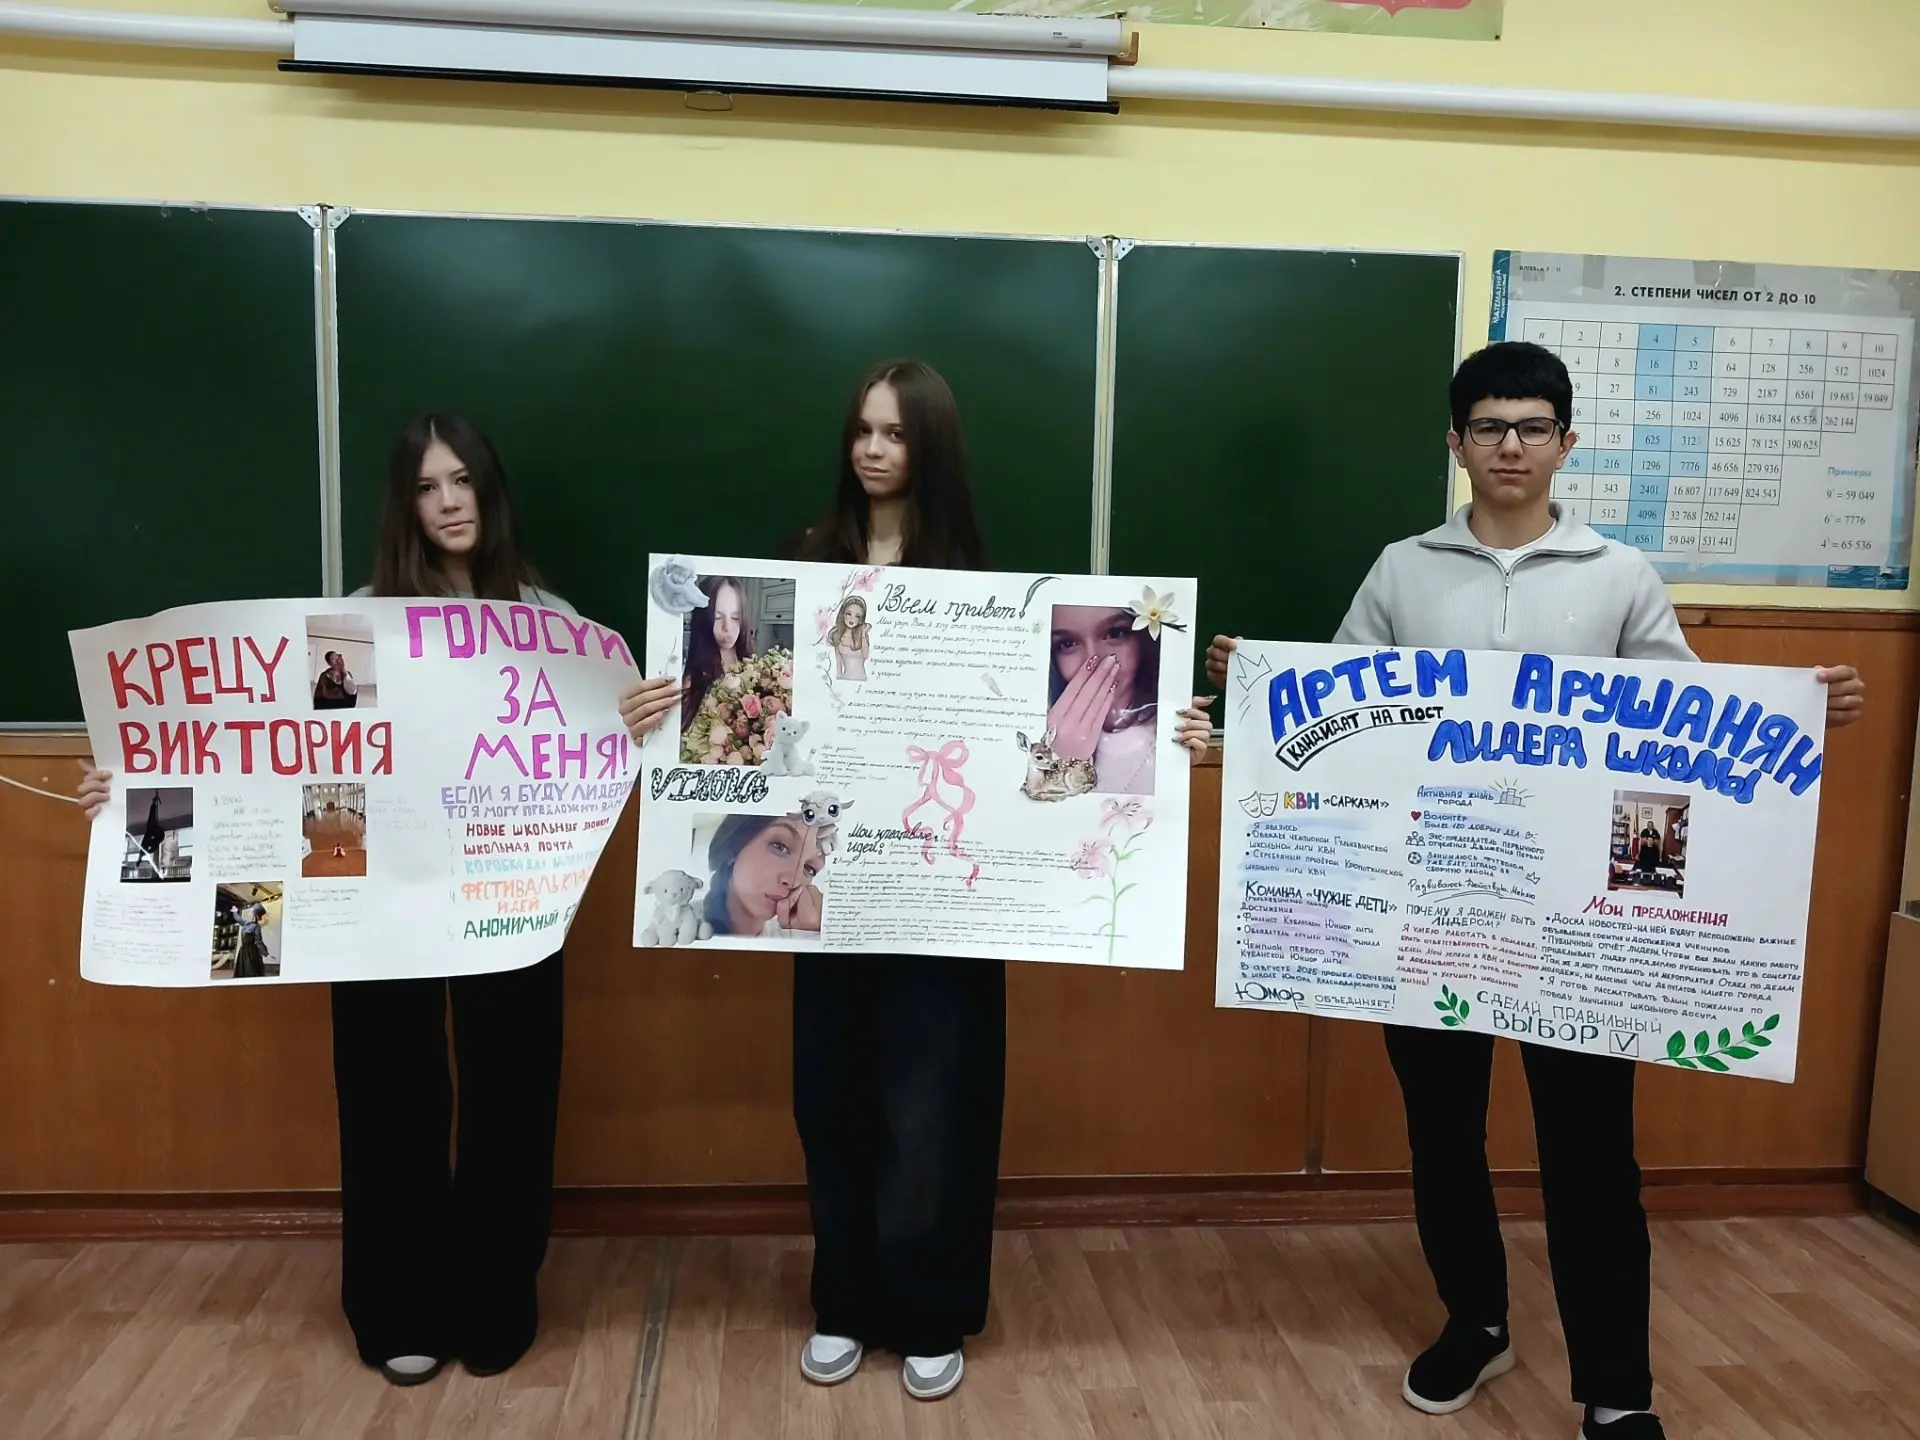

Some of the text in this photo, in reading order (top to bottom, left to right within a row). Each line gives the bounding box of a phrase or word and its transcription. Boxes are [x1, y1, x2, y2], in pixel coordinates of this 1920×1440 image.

[1614, 286, 1816, 305] 2. СТЕПЕНИ ЧИСЕЛ ОТ 2 ДО 10
[1577, 332, 1884, 353] 2 3 4 5 6 7 10
[1614, 358, 1886, 378] 8 16 32 64 128 256 512 1024
[1610, 384, 1814, 400] 27 81 243 729 2187 6561
[1609, 409, 1739, 422] 64 256 1024 4096
[1607, 434, 1660, 445] 125 625
[1569, 458, 1700, 471] 36 216 1296 7776
[1568, 483, 1659, 495] 49 343 2401
[1601, 509, 1657, 520] 512 4096
[1845, 515, 1866, 525] 7776
[1635, 533, 1654, 544] 6561
[878, 584, 937, 614] Всем
[108, 636, 289, 709] КРЕЦУ
[497, 666, 567, 726] ЗА
[1269, 648, 1822, 796] АРТЁМ АРУШАНЯН
[1286, 706, 1444, 761] КАНДИДАТ НА ПОСТ
[119, 721, 392, 775] ВИКТОРИЯ
[464, 733, 628, 780] МЕНЯ!
[1427, 719, 1762, 804] ЛИДЕРА ШКОЛЫ
[441, 783, 569, 804] ЕСЛИ Я БУДУ
[1283, 791, 1390, 810] КВН «САРКАЗМ»
[1417, 785, 1462, 798] АКТИВНАЯ
[444, 805, 467, 819] ТО
[471, 805, 480, 817] Я
[484, 805, 518, 818] МОГУ
[466, 823, 578, 837] НОВЫЕ ШКОЛЬНЫЕ
[1503, 829, 1520, 837] ДЕЛ
[464, 840, 573, 855] ШКОЛЬНАЯ ПОЧТА
[1318, 845, 1336, 855] КВН
[461, 874, 559, 901] ФЕСТИВАЛЬ
[1246, 880, 1302, 899] КОМАНДА
[1306, 888, 1352, 907] «ЧУЖИЕ
[1355, 895, 1397, 914] ДЕТИ»
[497, 897, 540, 914] ИДЕЙ
[1406, 904, 1536, 925] ПОЧЕМУ Я ДОЛЖЕН БЫТЬ
[464, 908, 559, 939] АНОНИМНЫЙ
[1431, 916, 1500, 928] ЛИДЕРОМ?
[1631, 905, 1729, 928] ПРЕДЛОЖЕНИЯ
[1445, 929, 1487, 939] РАБОТАТЬ
[1552, 912, 1585, 926] ДОСКА
[1650, 925, 1667, 934] НЕЙ
[1670, 928, 1696, 937] БУДУТ
[1759, 937, 1796, 945] ВАЖНЫЕ
[1331, 950, 1350, 959] ТУРА
[1296, 965, 1318, 976] 2025
[1560, 981, 1588, 991] ГОТОВ
[1235, 982, 1395, 1010] ЮМОР ОБЪЕДИНЯЕТ!
[1476, 990, 1662, 1034] СДЕЛАЙ ПРАВИЛЬНЫЙ
[1492, 1009, 1599, 1045] ВЫБОР
